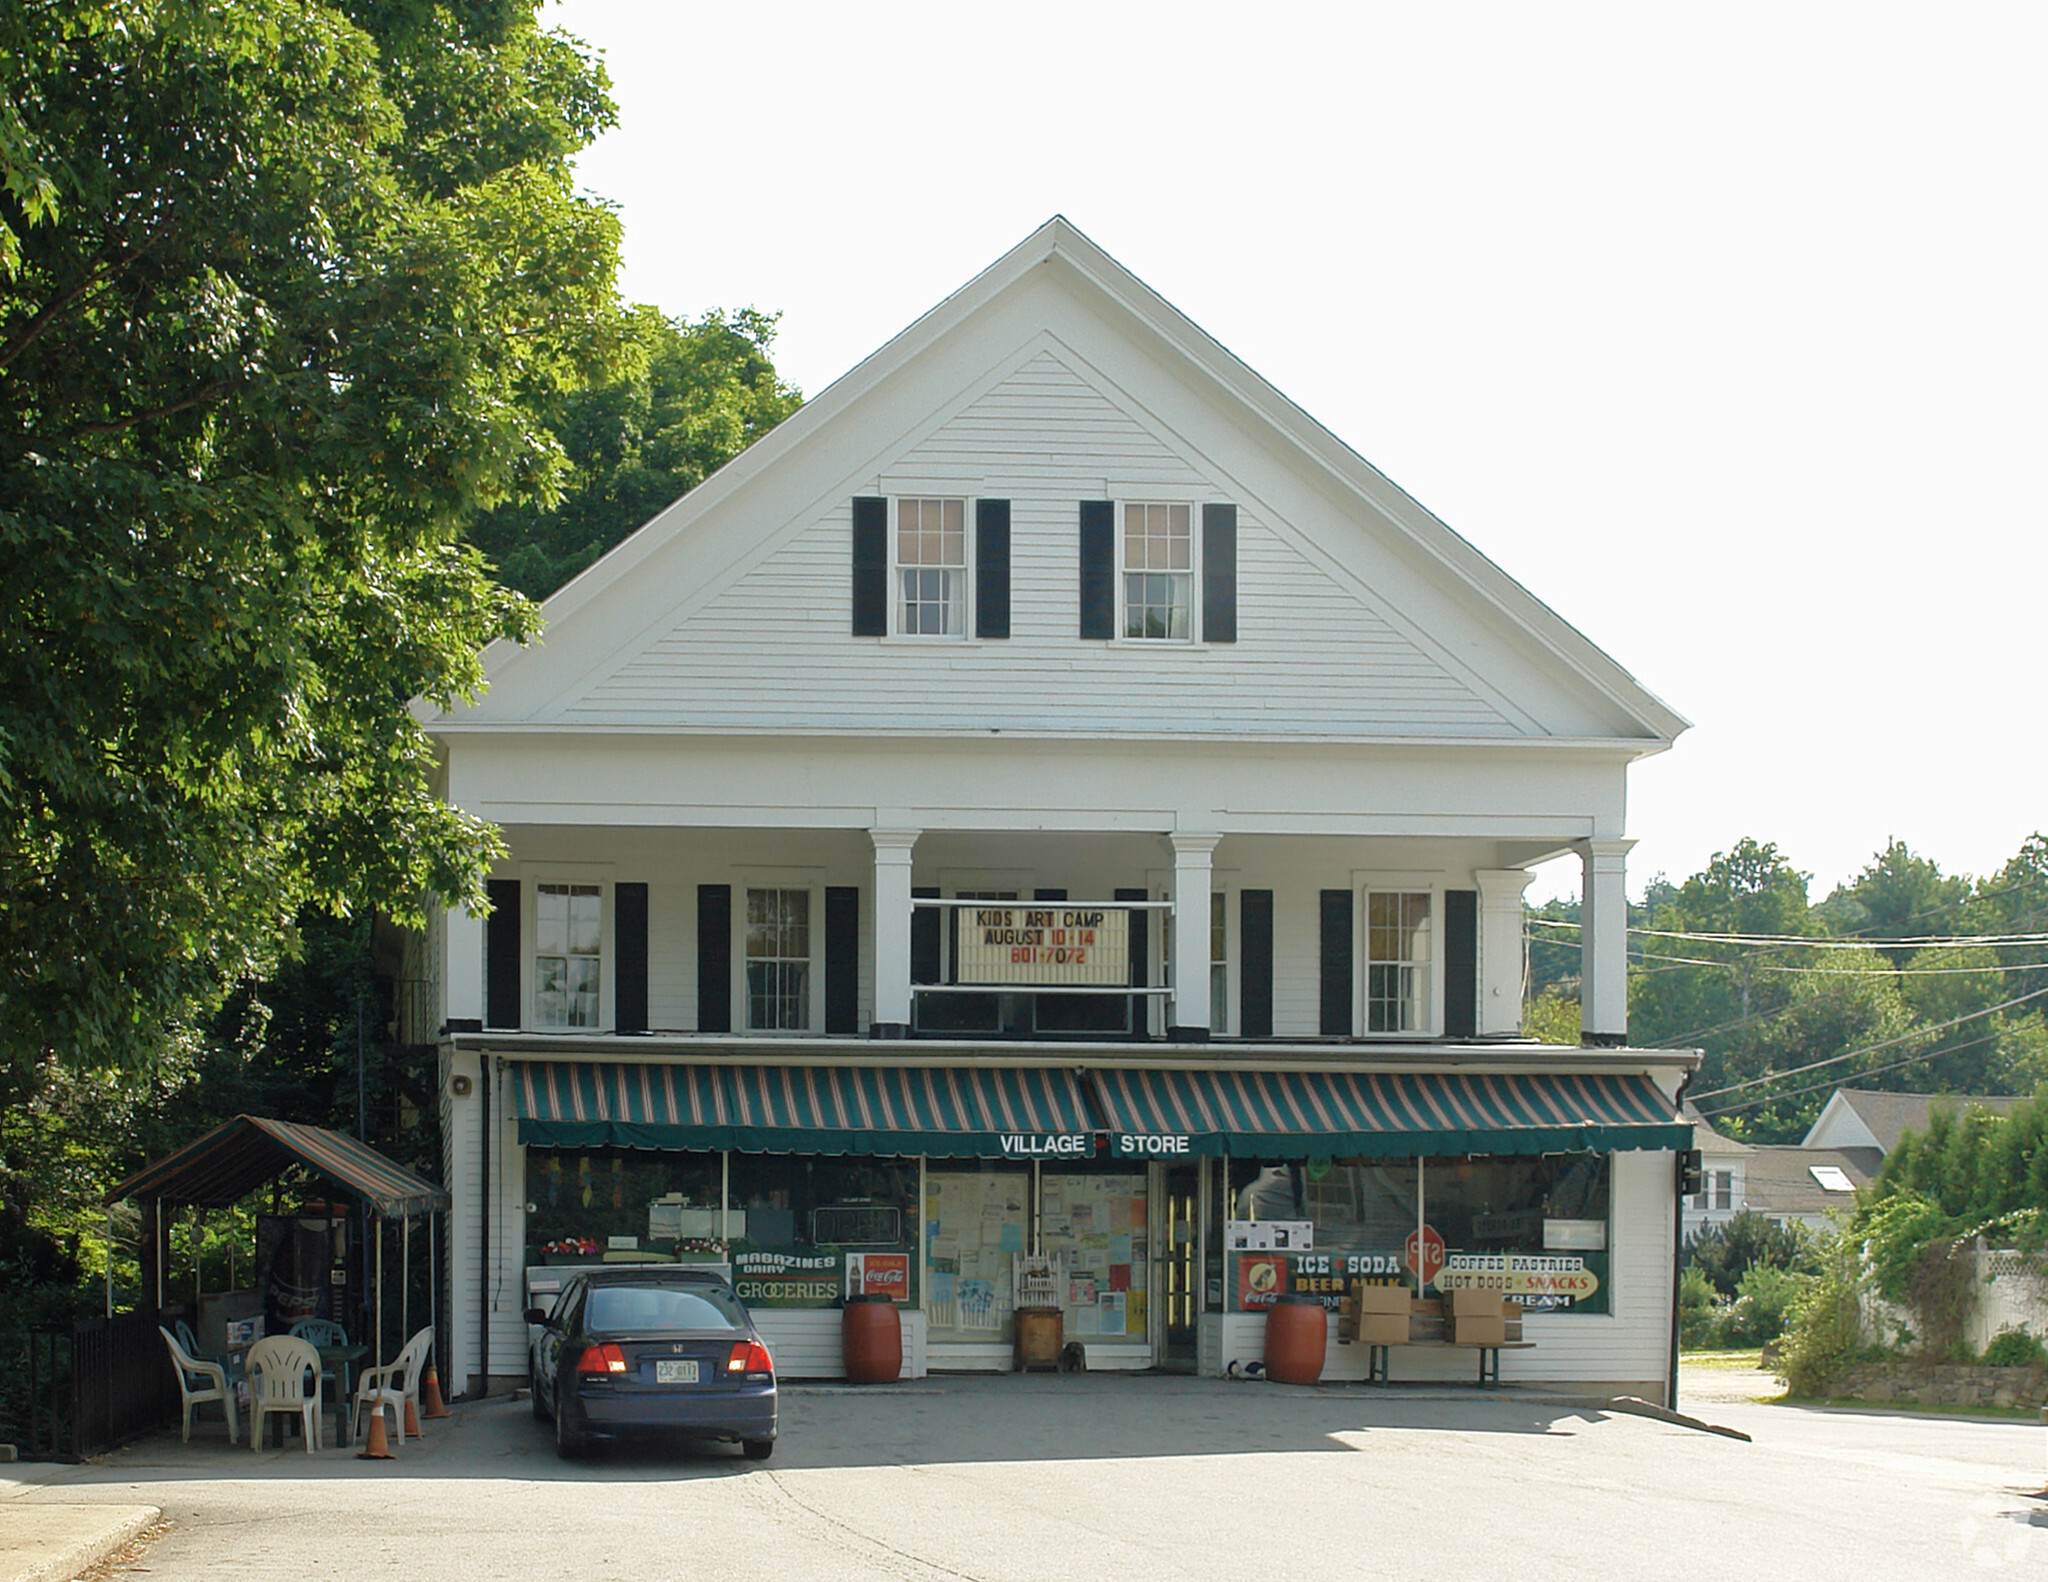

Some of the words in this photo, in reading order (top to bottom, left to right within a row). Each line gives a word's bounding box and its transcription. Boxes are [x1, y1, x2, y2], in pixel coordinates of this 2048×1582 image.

[977, 911, 1012, 927] KIDS
[1025, 911, 1054, 927] ART
[1064, 912, 1104, 927] CAMP
[984, 929, 1044, 945] AUGUST
[1000, 1135, 1085, 1153] VILLAGE
[1121, 1135, 1190, 1153] STORE
[735, 1252, 836, 1269] MAGAZINES
[1297, 1256, 1330, 1274] ICE
[1348, 1256, 1401, 1274] SODA
[1450, 1257, 1505, 1270] COFFEE
[1511, 1257, 1582, 1272] PASTRIES
[743, 1265, 785, 1274] DAIRY
[735, 1281, 838, 1299] GROCERIES
[1295, 1278, 1345, 1292] BEER
[1443, 1275, 1472, 1288] HOT
[1477, 1275, 1513, 1290] DOGS
[1526, 1276, 1589, 1290] SNACKS
[268, 1283, 320, 1309] PEPSI
[1502, 1294, 1570, 1307] CREAM
